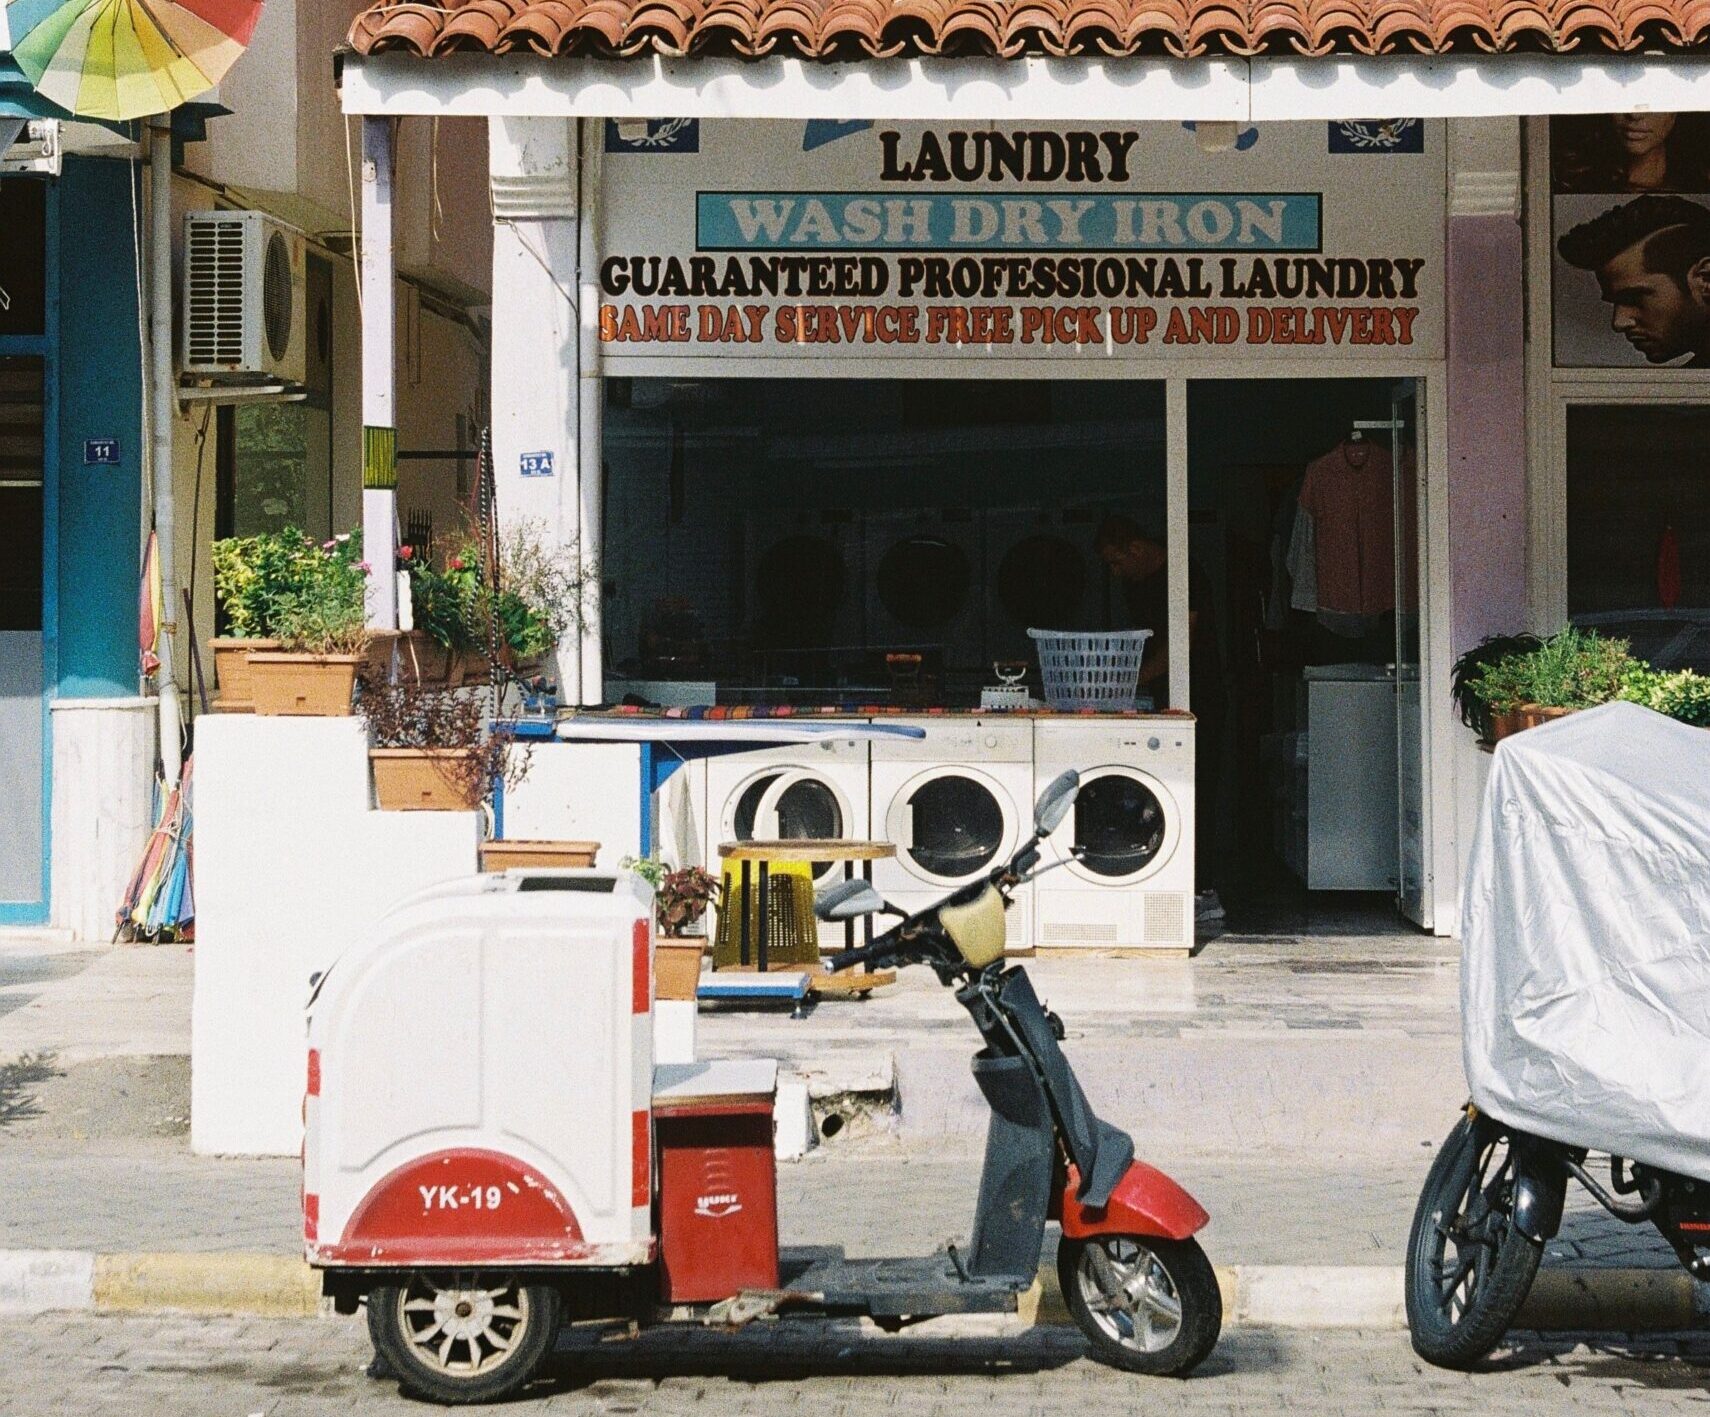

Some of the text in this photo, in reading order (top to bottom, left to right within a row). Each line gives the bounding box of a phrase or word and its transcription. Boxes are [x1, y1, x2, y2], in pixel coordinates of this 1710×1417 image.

[879, 130, 1140, 182] LAUNDRY
[729, 198, 1288, 245] WASH DRY IRON
[600, 256, 1426, 299] GUARANTEED PROFESSIONAL LAUNDRY
[599, 304, 1420, 346] SAME DAY SERVICE FREE PICK UP AND DELIVERY
[95, 446, 110, 457] 11
[521, 458, 537, 470] 13
[419, 1185, 501, 1210] YK-19
